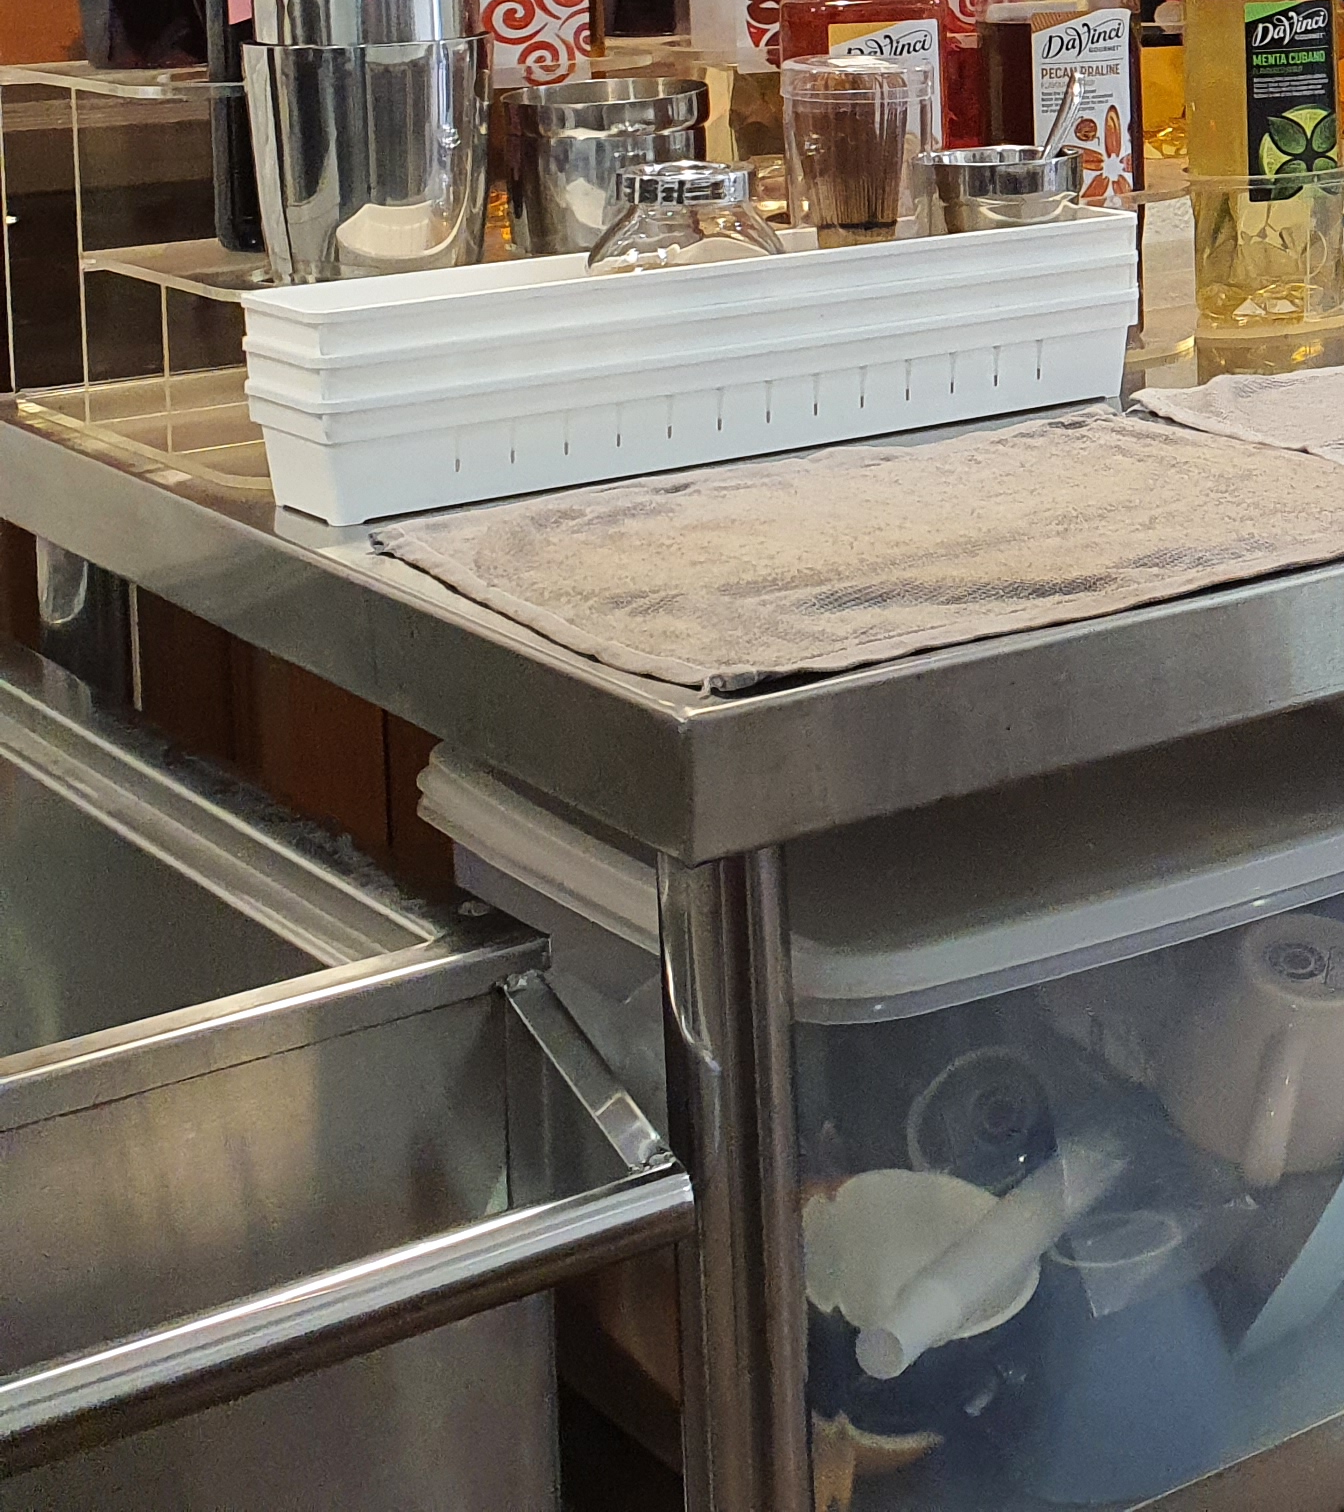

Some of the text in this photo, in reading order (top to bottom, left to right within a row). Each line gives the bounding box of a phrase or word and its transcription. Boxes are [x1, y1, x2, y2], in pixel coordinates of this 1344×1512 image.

[1042, 18, 1125, 59] DaVinci
[1252, 7, 1328, 46] DaVinci
[1252, 50, 1325, 66] MENTA CUBANO
